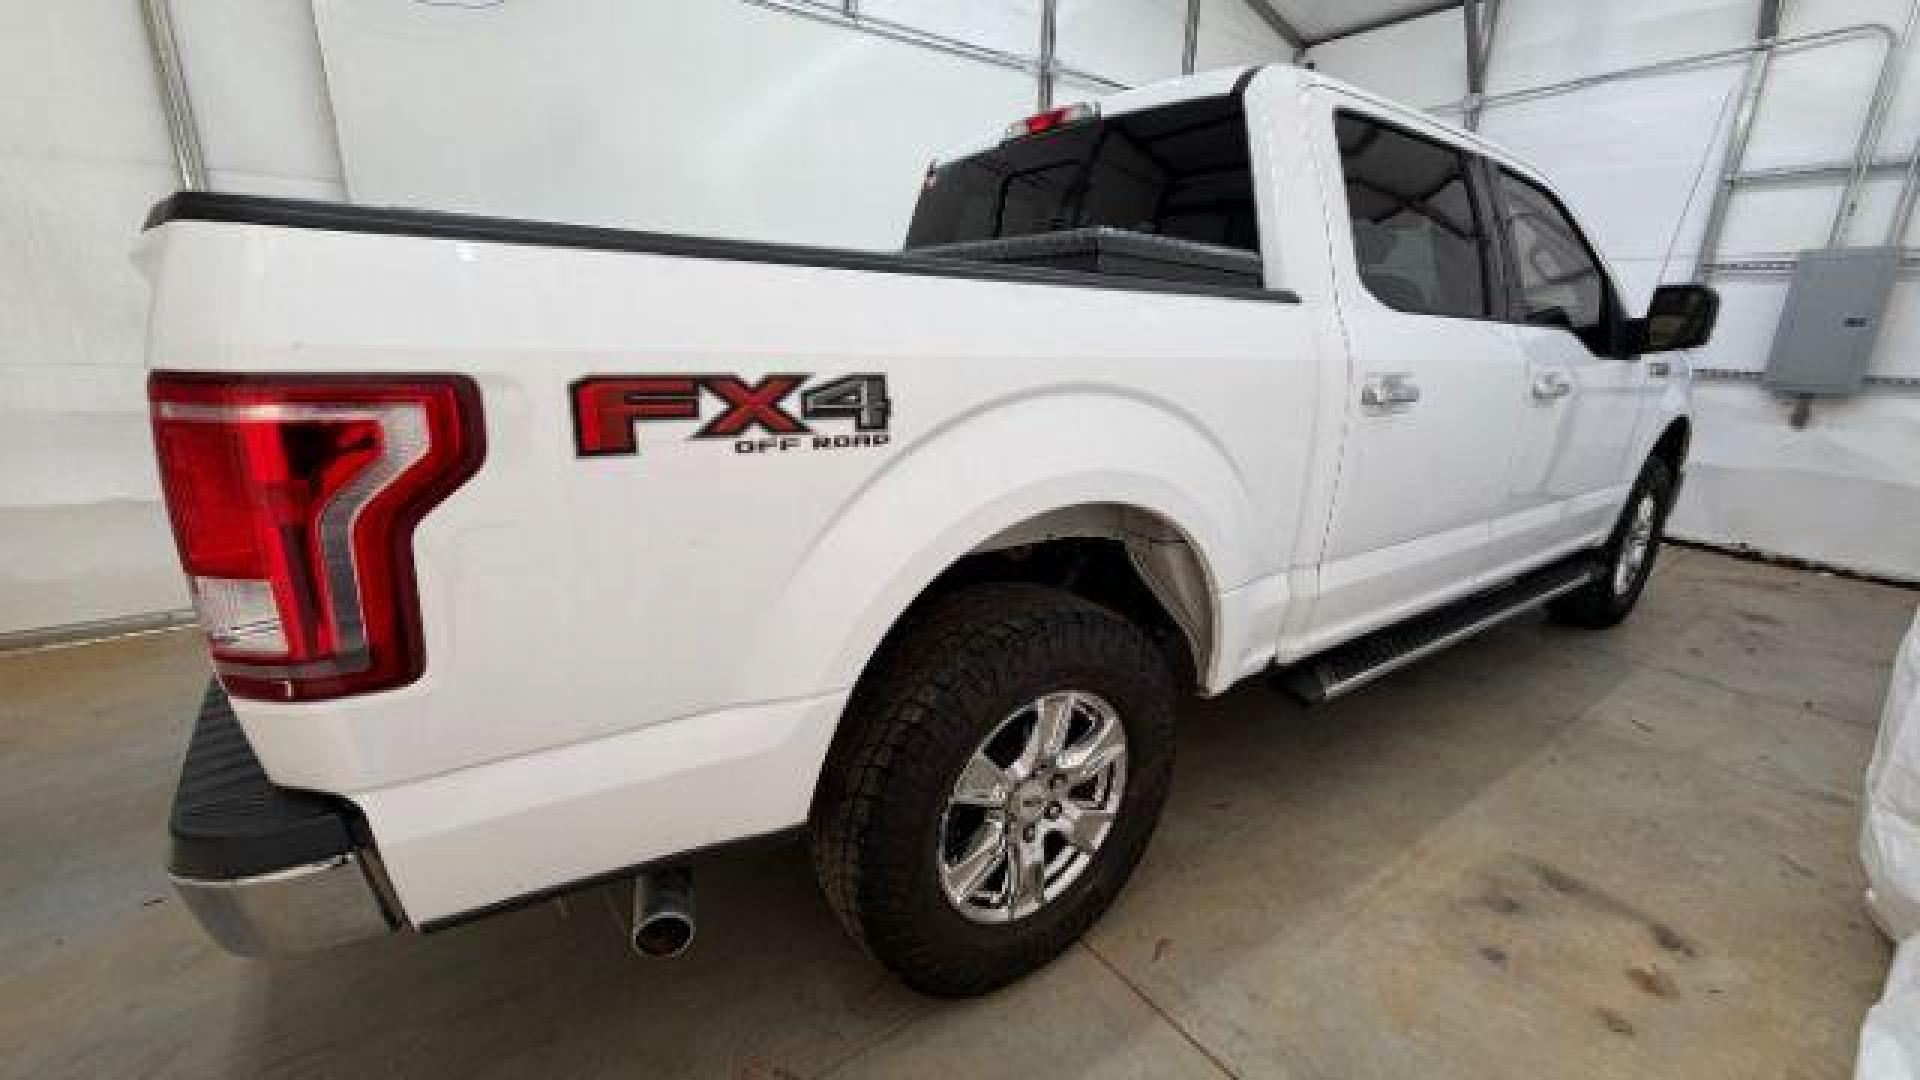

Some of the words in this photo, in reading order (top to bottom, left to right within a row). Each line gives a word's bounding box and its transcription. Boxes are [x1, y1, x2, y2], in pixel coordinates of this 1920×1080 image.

[569, 372, 891, 457] FX4
[734, 438, 800, 454] OFF
[812, 434, 890, 450] ROAD
